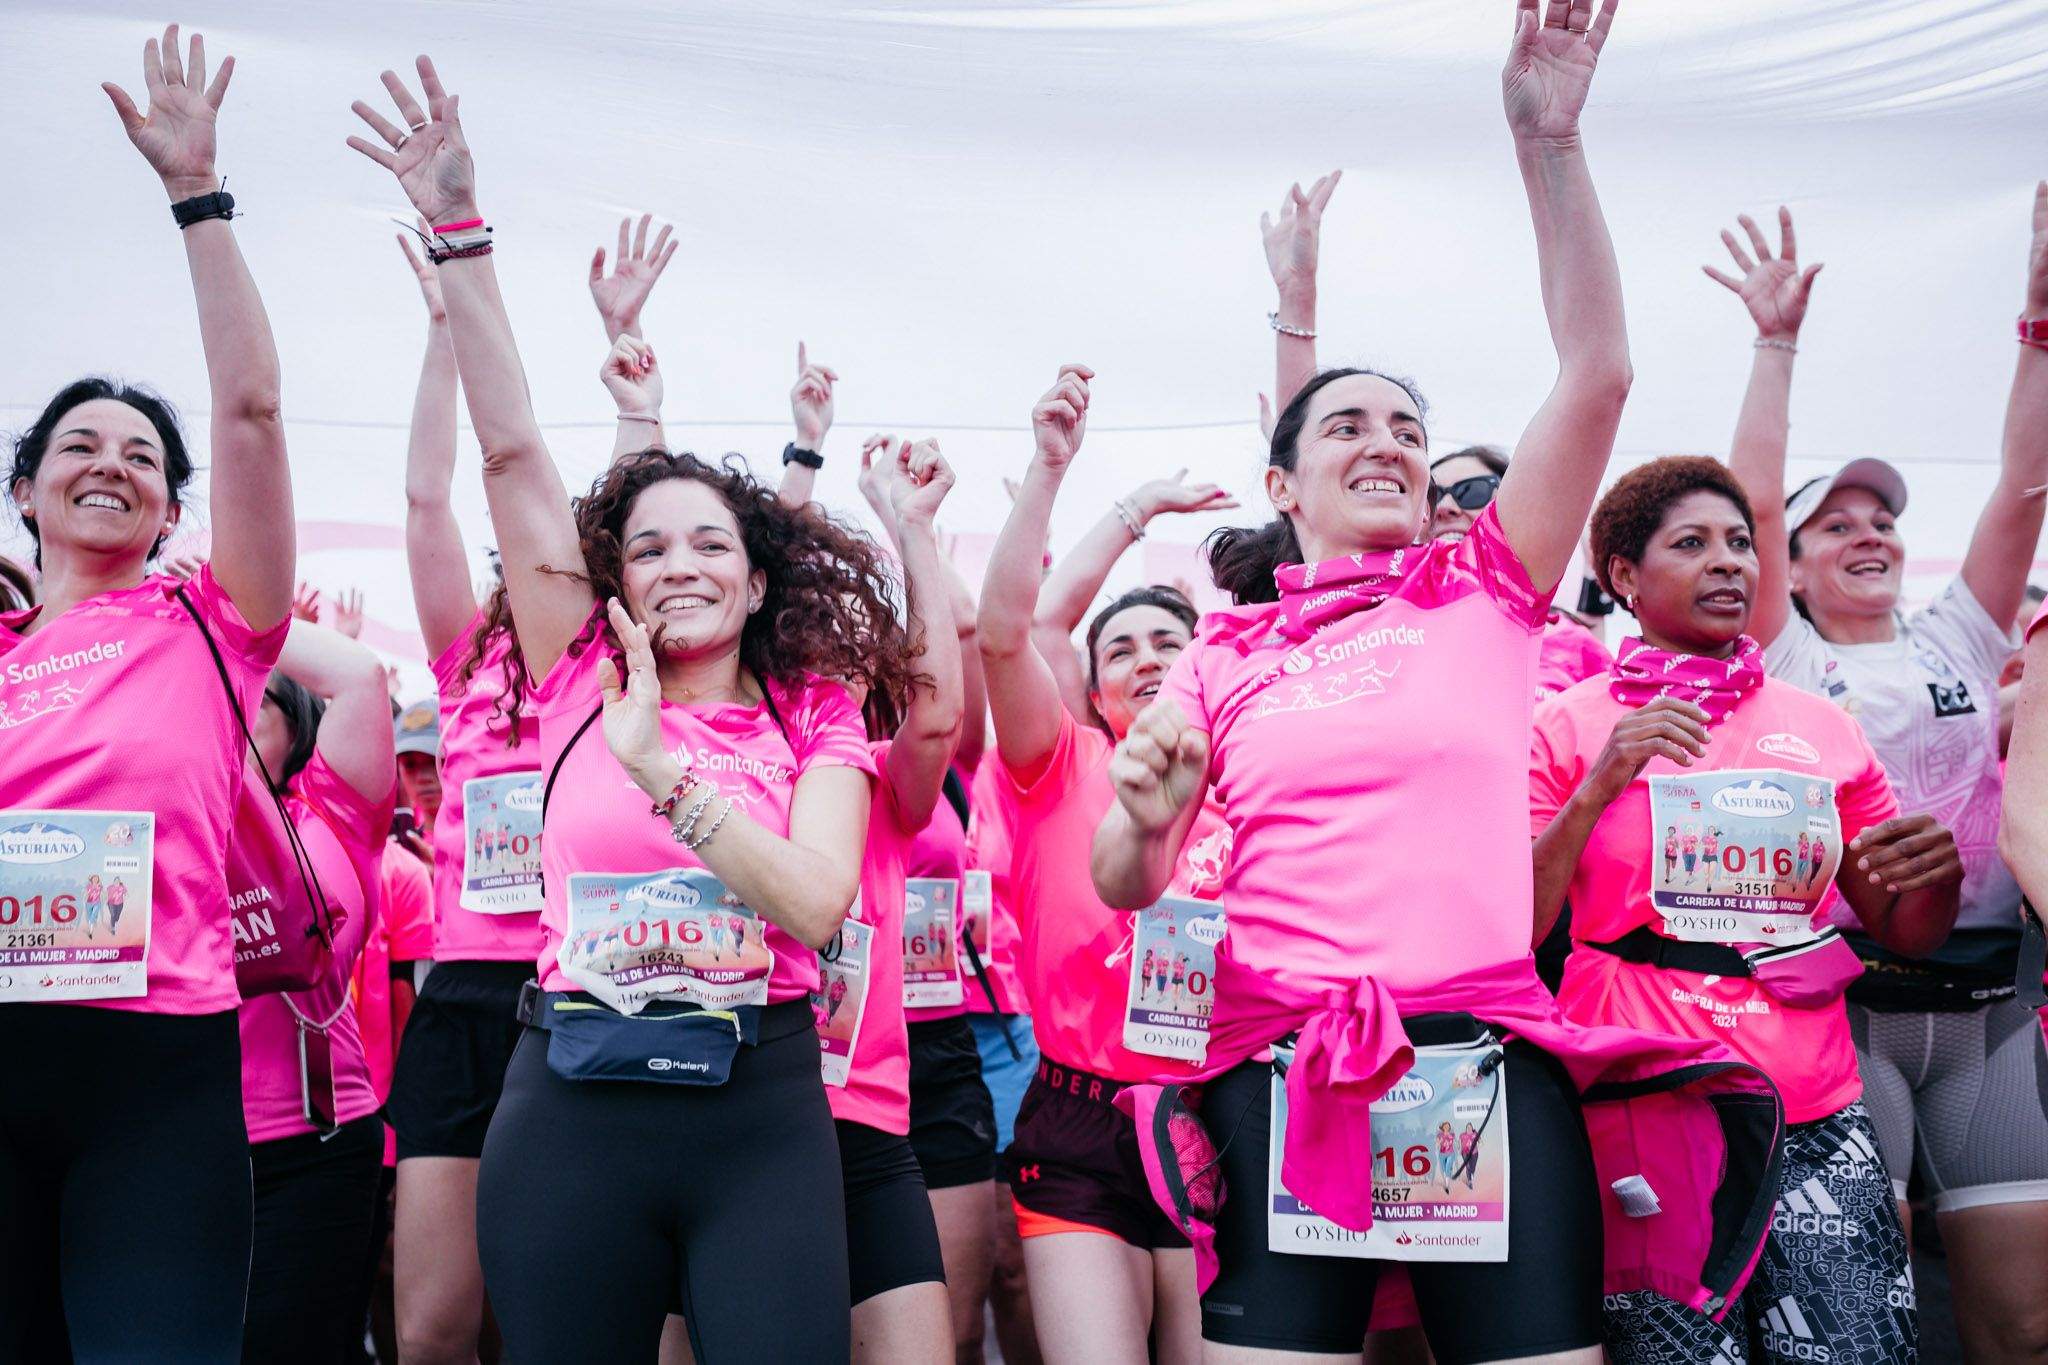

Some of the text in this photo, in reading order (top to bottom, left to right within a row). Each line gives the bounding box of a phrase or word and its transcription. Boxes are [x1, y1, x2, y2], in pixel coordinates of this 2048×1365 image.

[1315, 624, 1425, 668] Santander
[7, 640, 125, 685] Santander
[695, 748, 793, 784] Santander
[510, 793, 542, 806] ASTUR
[1717, 793, 1791, 812] ASTURIANA
[0, 841, 79, 855] ASTURIANA
[1722, 845, 1793, 877] 016
[481, 873, 536, 888] CARRERA DE LA
[480, 891, 526, 905] OYSHO
[1675, 895, 1721, 907] CARRERA
[1724, 897, 1736, 908] DE
[1740, 900, 1753, 910] LA
[0, 893, 77, 925] 016
[231, 908, 276, 944] AN
[1190, 922, 1224, 940] ASTUR
[1673, 915, 1737, 930] OYSHO
[7, 932, 55, 947] 21361
[623, 919, 703, 947] 016
[14, 951, 27, 963] LA
[31, 950, 66, 962] MUJER
[76, 948, 120, 961] MADRID
[234, 941, 281, 963] an.es
[639, 950, 684, 965] 16243
[57, 973, 121, 987] Santander
[630, 969, 644, 980] DE
[646, 966, 659, 976] LA
[662, 963, 695, 977] MUJER
[703, 970, 745, 983] MADRID
[1148, 1012, 1208, 1030] CARRERA DE LA
[1712, 1013, 1737, 1028] 2024
[1144, 1031, 1197, 1049] OYSHO
[673, 1061, 709, 1073] Kalenji
[1040, 1062, 1102, 1102] NDER
[1381, 1088, 1426, 1102] RIANA
[1375, 1145, 1431, 1178] 16
[1371, 1187, 1411, 1202] 4657
[1385, 1205, 1423, 1218] MUJER
[1433, 1205, 1478, 1218] MADRID
[1295, 1224, 1368, 1242] OYSHO
[1773, 1211, 1860, 1237] didas
[1414, 1233, 1481, 1247] Santander
[1763, 1330, 1831, 1363] didas
